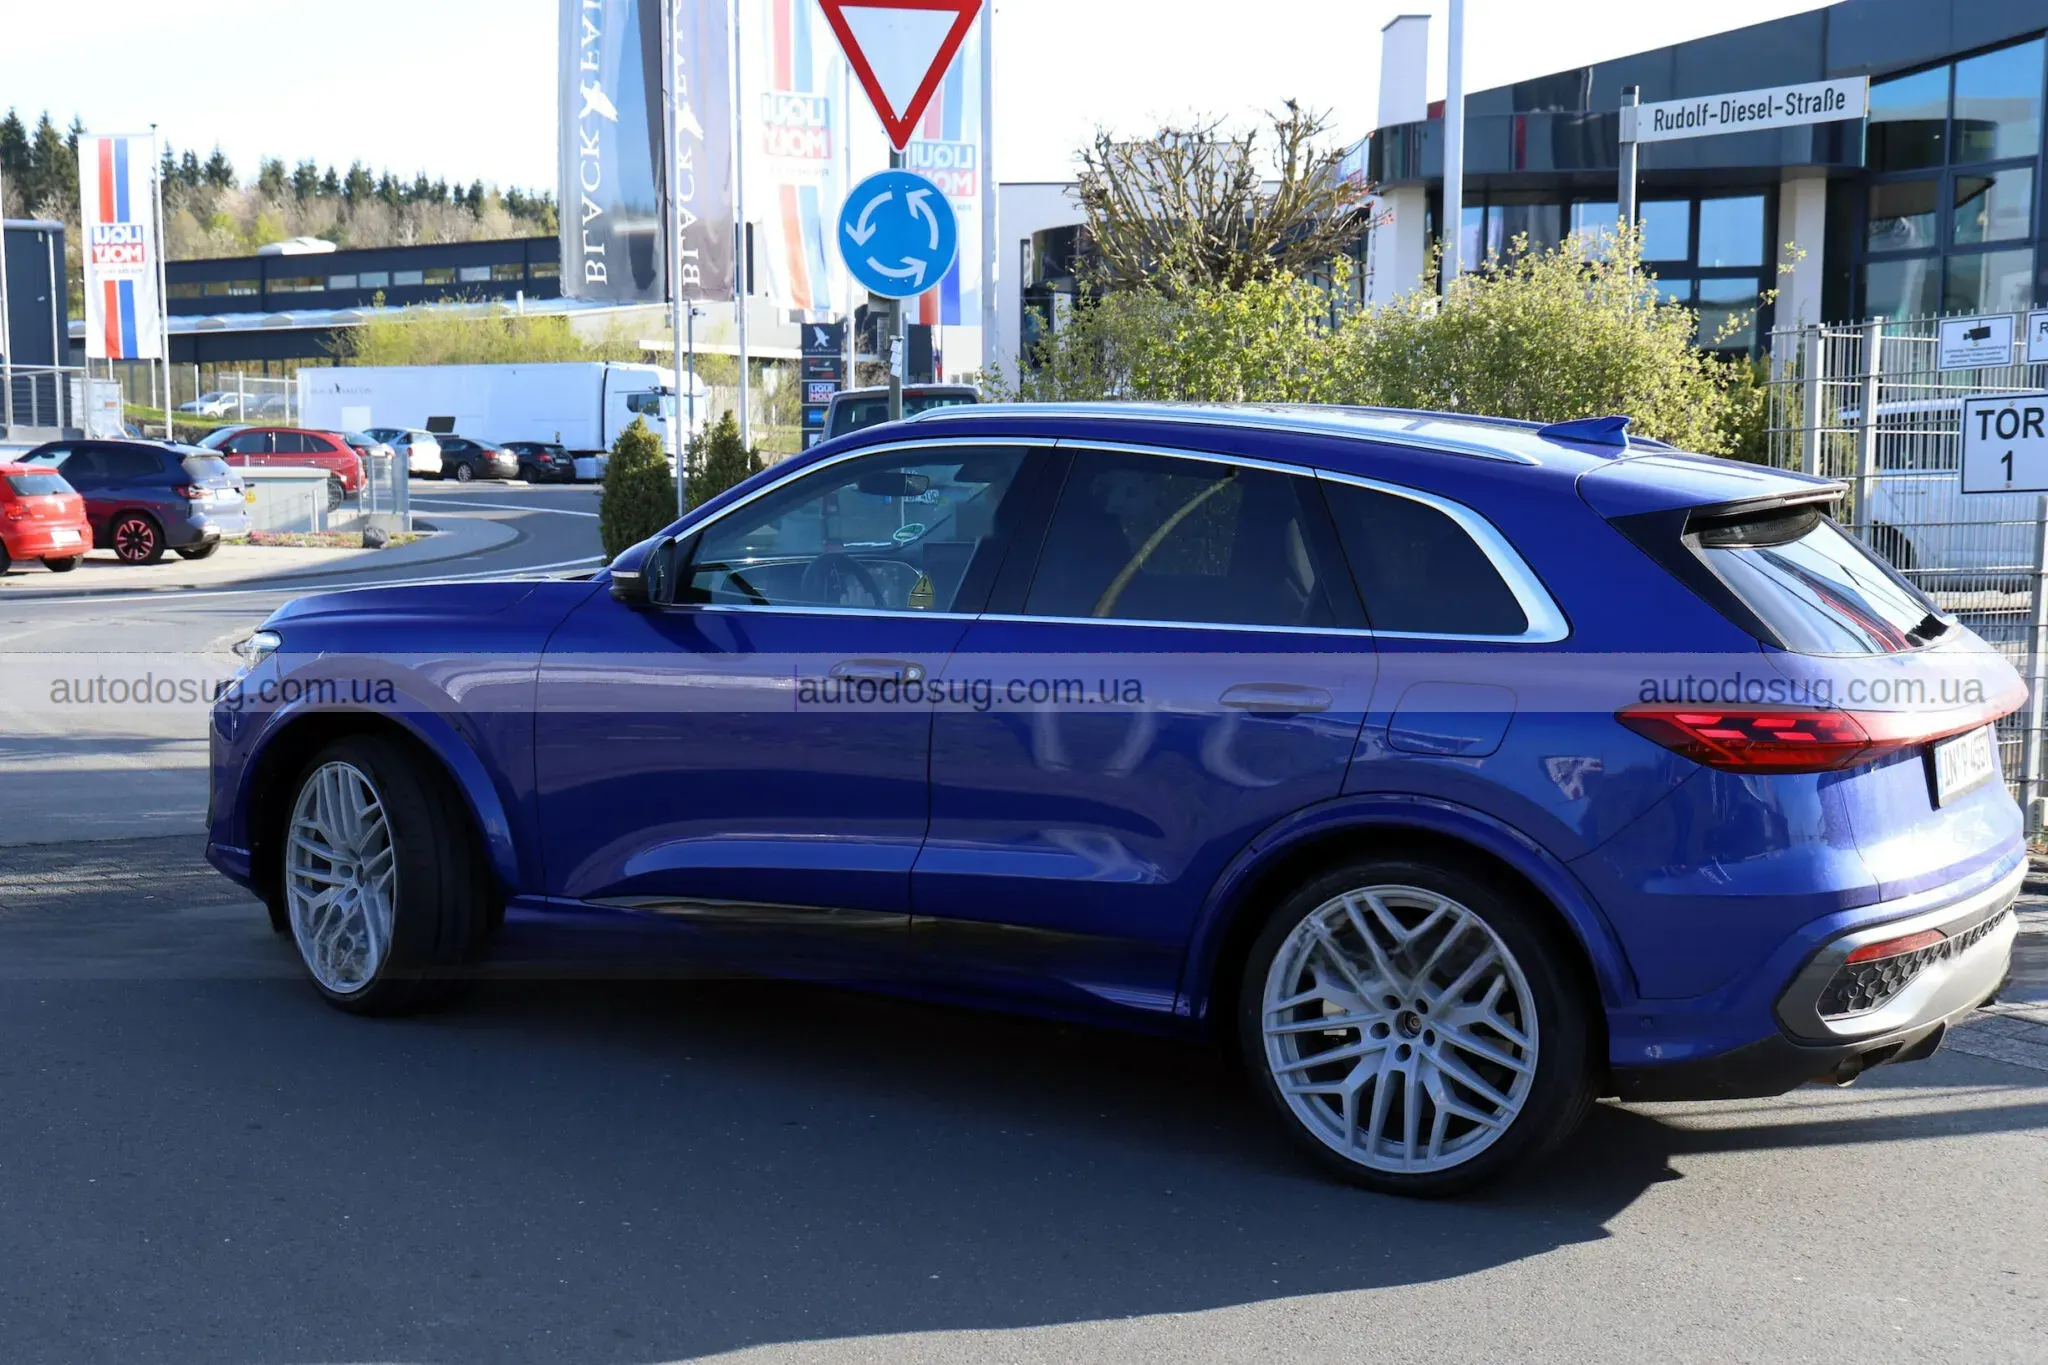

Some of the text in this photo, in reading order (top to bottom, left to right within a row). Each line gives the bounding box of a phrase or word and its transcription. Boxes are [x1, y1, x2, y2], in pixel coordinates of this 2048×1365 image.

[1653, 87, 1846, 132] Rudolf-Diesel-Straße
[810, 384, 834, 393] LIQUI
[1975, 407, 2045, 441] TOR
[2001, 450, 2013, 482] 1
